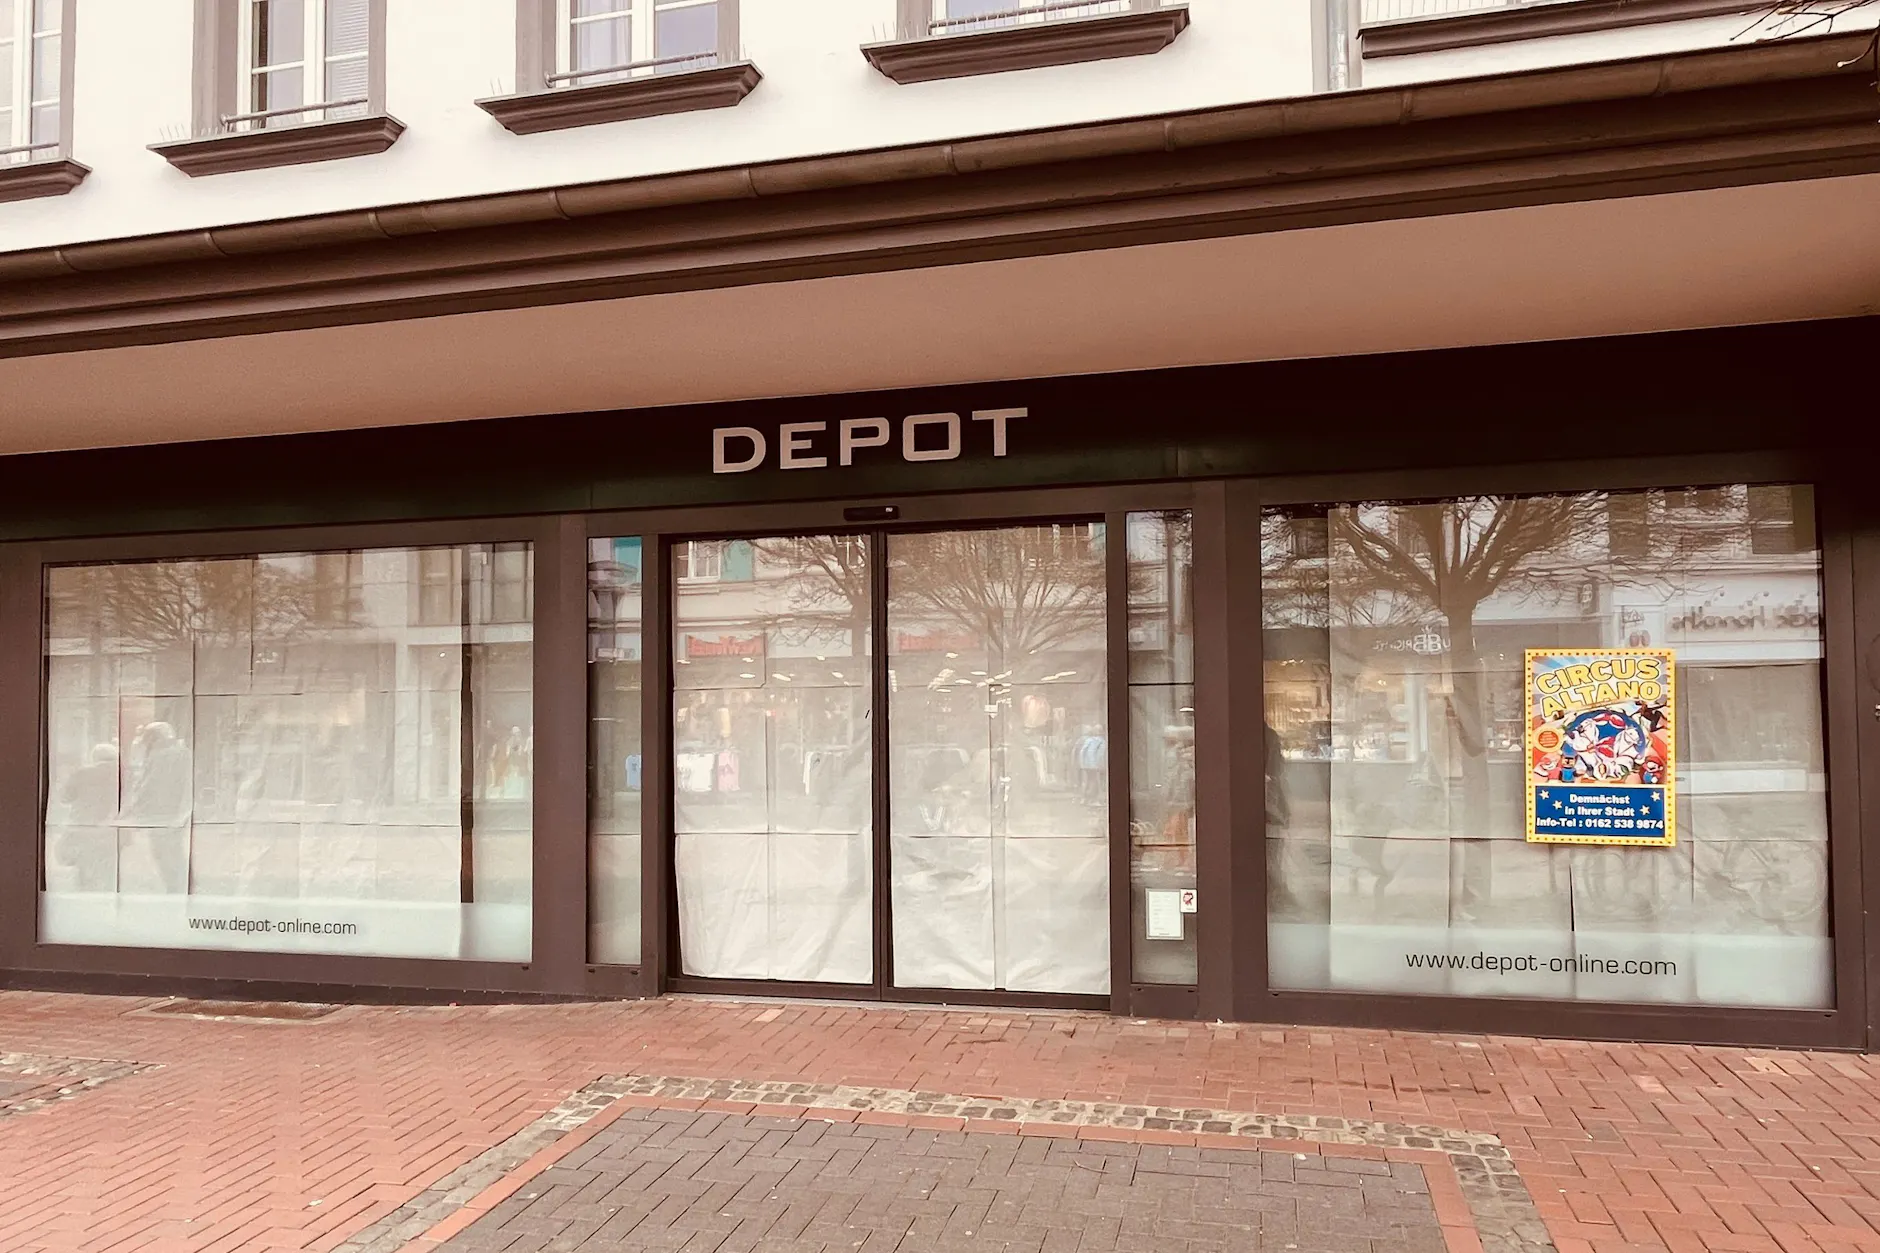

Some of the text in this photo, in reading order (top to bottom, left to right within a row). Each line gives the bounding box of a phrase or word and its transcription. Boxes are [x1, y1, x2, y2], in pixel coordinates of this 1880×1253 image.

[712, 407, 1029, 474] DEPOT
[1535, 658, 1661, 694] CIRCUS
[1541, 680, 1661, 718] ALTANO
[1569, 793, 1630, 804] Demnächst
[1577, 806, 1603, 816] Ihrer
[1604, 806, 1635, 817] Stadt
[1536, 817, 1577, 827] Info-Tel
[1585, 818, 1611, 828] 0162
[1613, 819, 1634, 829] 538
[1636, 819, 1664, 829] 9874
[188, 916, 358, 936] www.depot-online.com
[1405, 951, 1677, 976] www.depot-online.com
